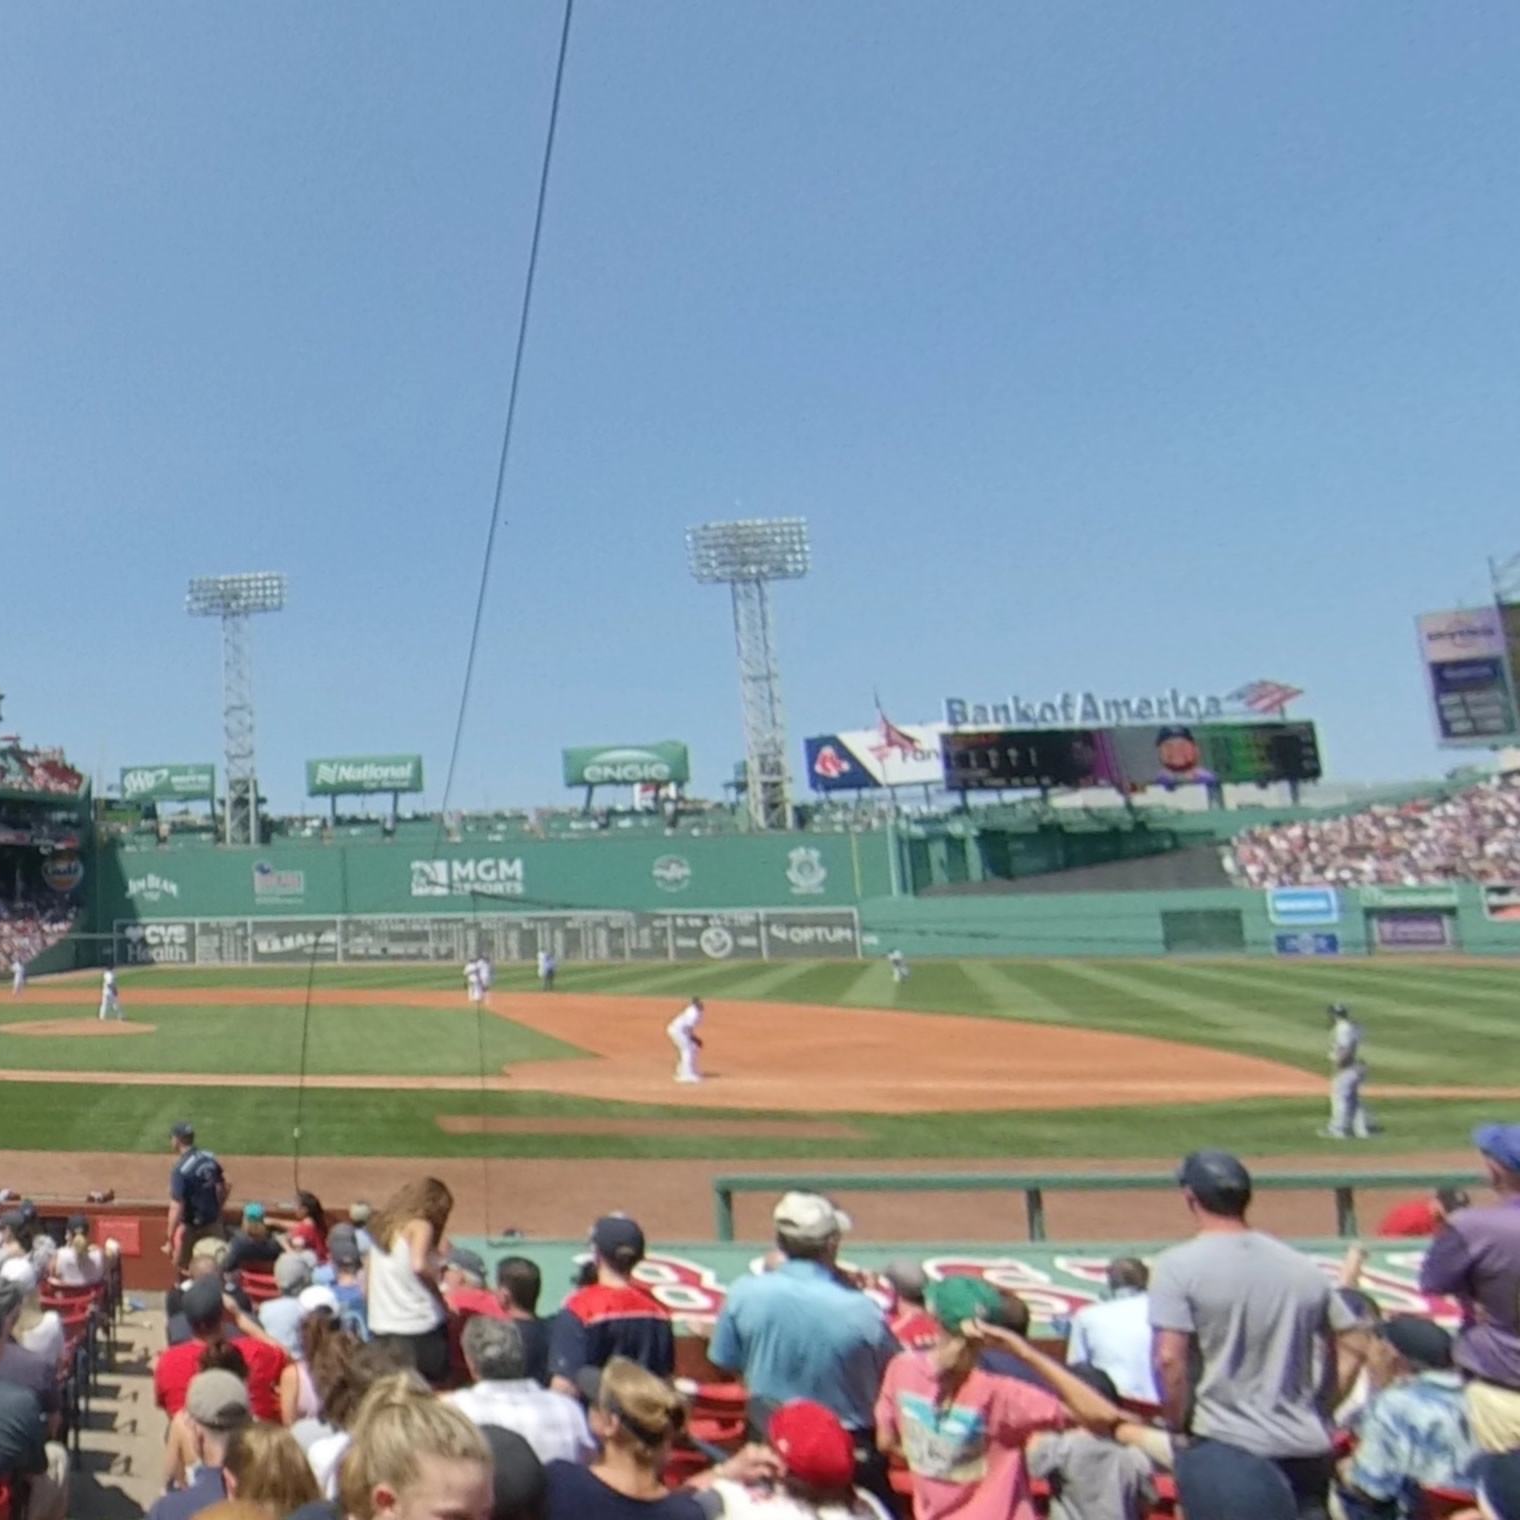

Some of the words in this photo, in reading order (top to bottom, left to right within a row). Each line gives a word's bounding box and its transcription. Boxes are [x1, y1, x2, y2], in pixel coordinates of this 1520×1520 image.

[944, 695, 1037, 726] Bank
[1038, 692, 1073, 722] of
[1080, 689, 1223, 722] America
[337, 762, 412, 783] National
[452, 858, 523, 881] MGM
[145, 925, 187, 944] CVS
[789, 926, 853, 943] OPTUM
[128, 943, 188, 962] Health
